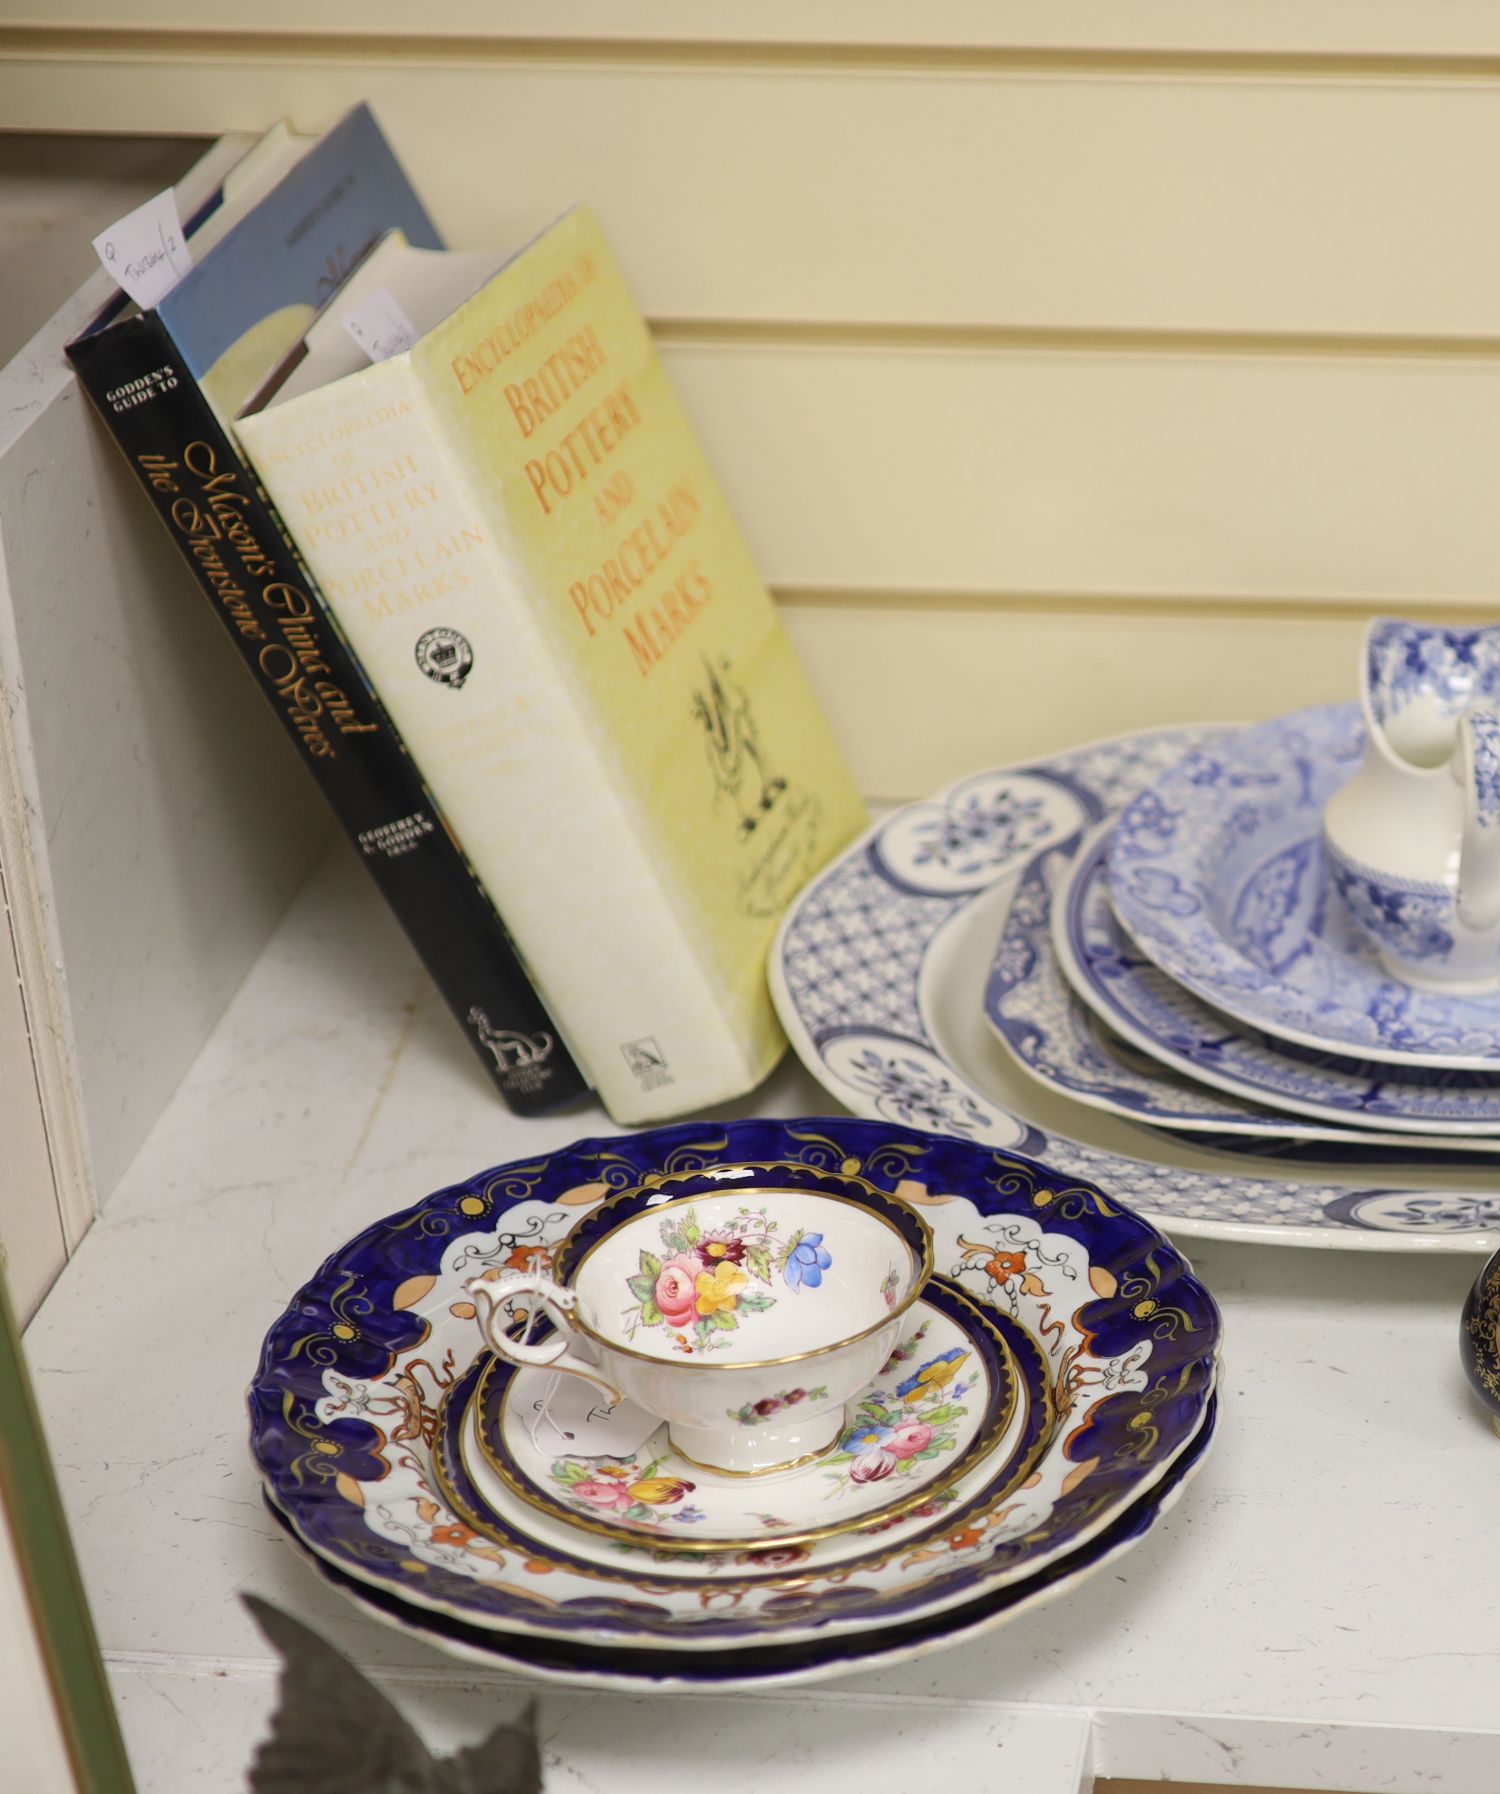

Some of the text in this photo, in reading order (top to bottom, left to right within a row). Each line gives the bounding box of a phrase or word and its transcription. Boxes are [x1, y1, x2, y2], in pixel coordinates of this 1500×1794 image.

[106, 364, 174, 402] GODDEN'S
[113, 376, 179, 413] GUIDE TO
[503, 324, 608, 439] BRITISH
[524, 385, 640, 515] POTTERY
[301, 454, 419, 517] BRITISH
[303, 478, 442, 549] POTTERY
[595, 469, 636, 524] AND
[320, 522, 486, 598] PORCELAIN
[364, 526, 410, 556] AND
[569, 478, 702, 637] PORCELAIN
[138, 455, 336, 758] the Ironstone Wares
[184, 441, 378, 734] Mason's China and
[362, 567, 471, 623] MARKS
[623, 559, 713, 678] MARKS
[358, 811, 425, 846] GEOFFREY
[377, 819, 434, 850] GODDEN
